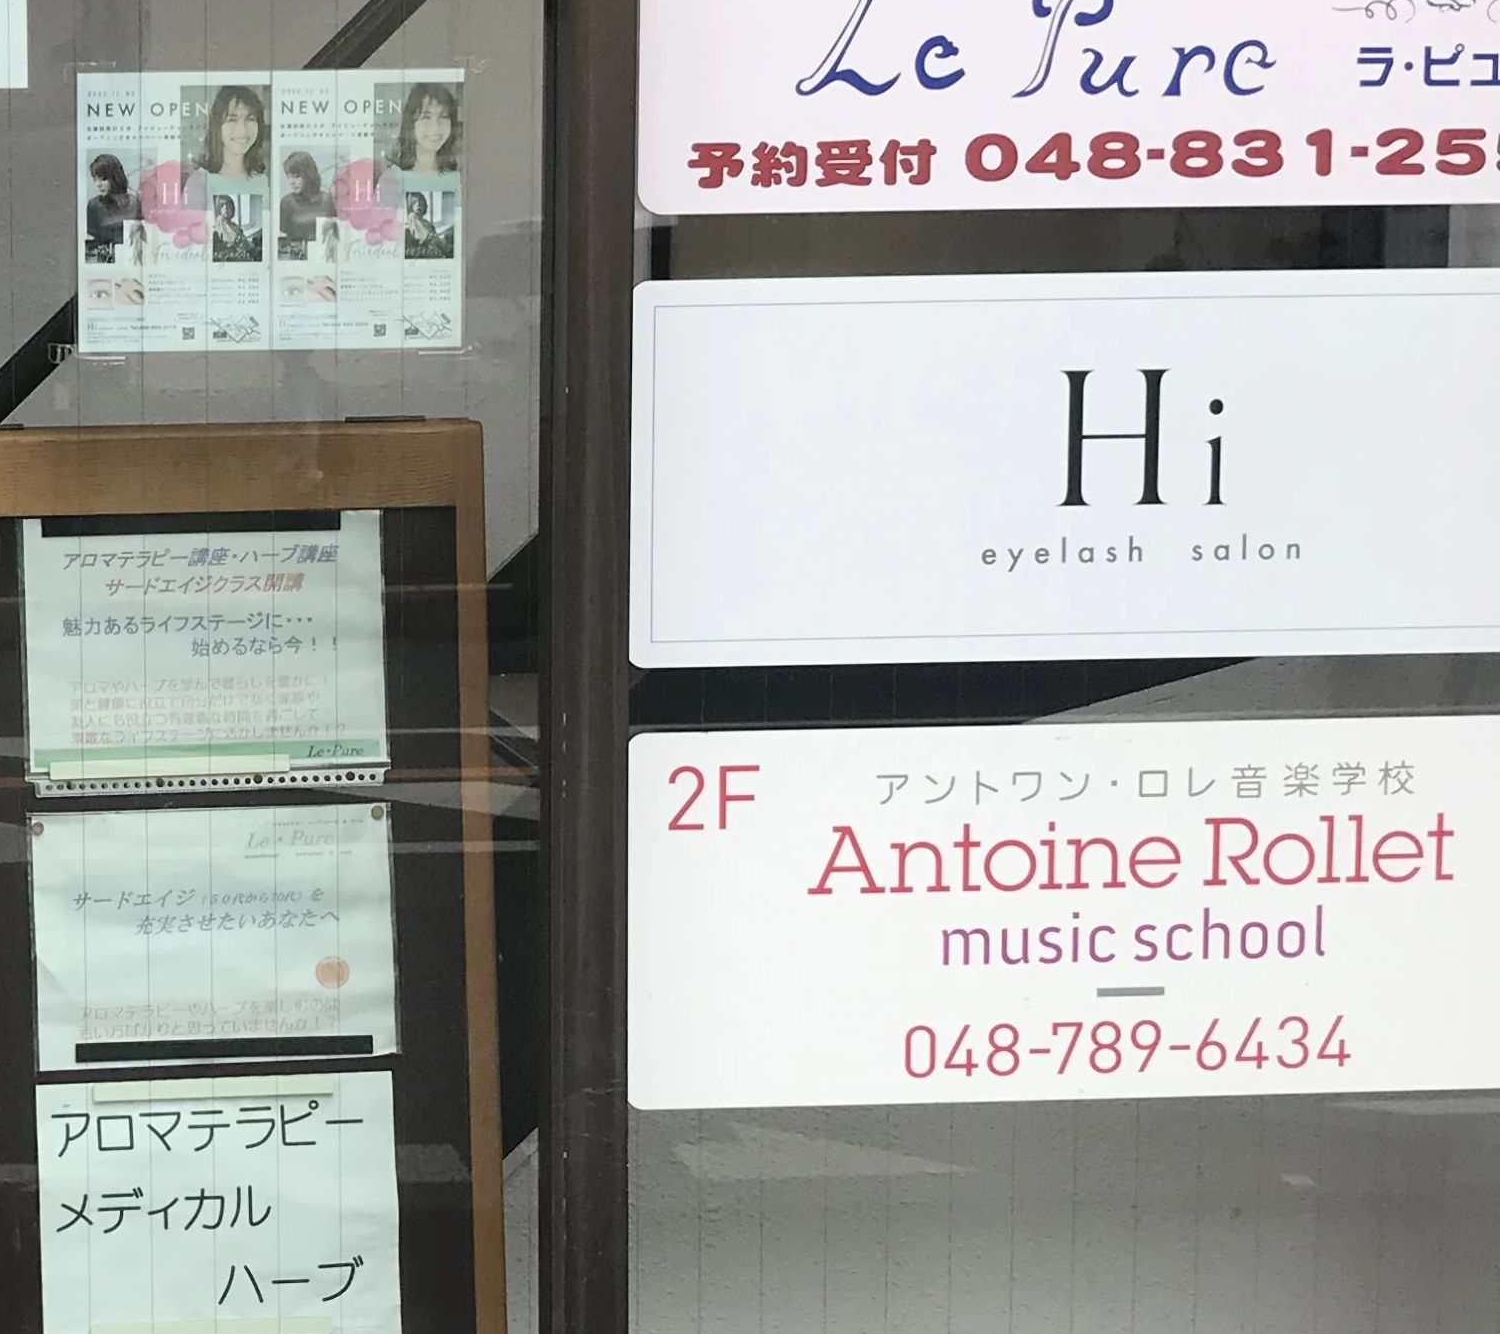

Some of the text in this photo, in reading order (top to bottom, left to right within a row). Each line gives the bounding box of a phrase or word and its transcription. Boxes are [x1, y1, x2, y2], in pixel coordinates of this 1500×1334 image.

[87, 102, 209, 117] NEW OPEN
[281, 99, 402, 115] NEW OPEN
[686, 127, 1500, 190] 予約受付 048-831-25
[162, 182, 189, 206] Hi
[354, 179, 381, 203] Hi
[1055, 367, 1229, 508] Hi
[62, 542, 339, 570] アロマテラピー講座・ハーブ講座
[981, 534, 1303, 574] eyelash salon
[105, 572, 304, 597] サードエイジクラス開講
[666, 764, 762, 832] 2F
[875, 759, 1416, 806] アントワン・ロレ音楽学校
[807, 812, 1456, 896] Antoine Rollet
[134, 909, 342, 938] 充実させたいあなたへ
[941, 905, 1326, 967] music school
[903, 1014, 1353, 1080] 048-789-6434
[51, 1099, 364, 1157] アロマテラピー
[55, 1183, 271, 1234] メディカル
[218, 1255, 365, 1305] ハーブ
